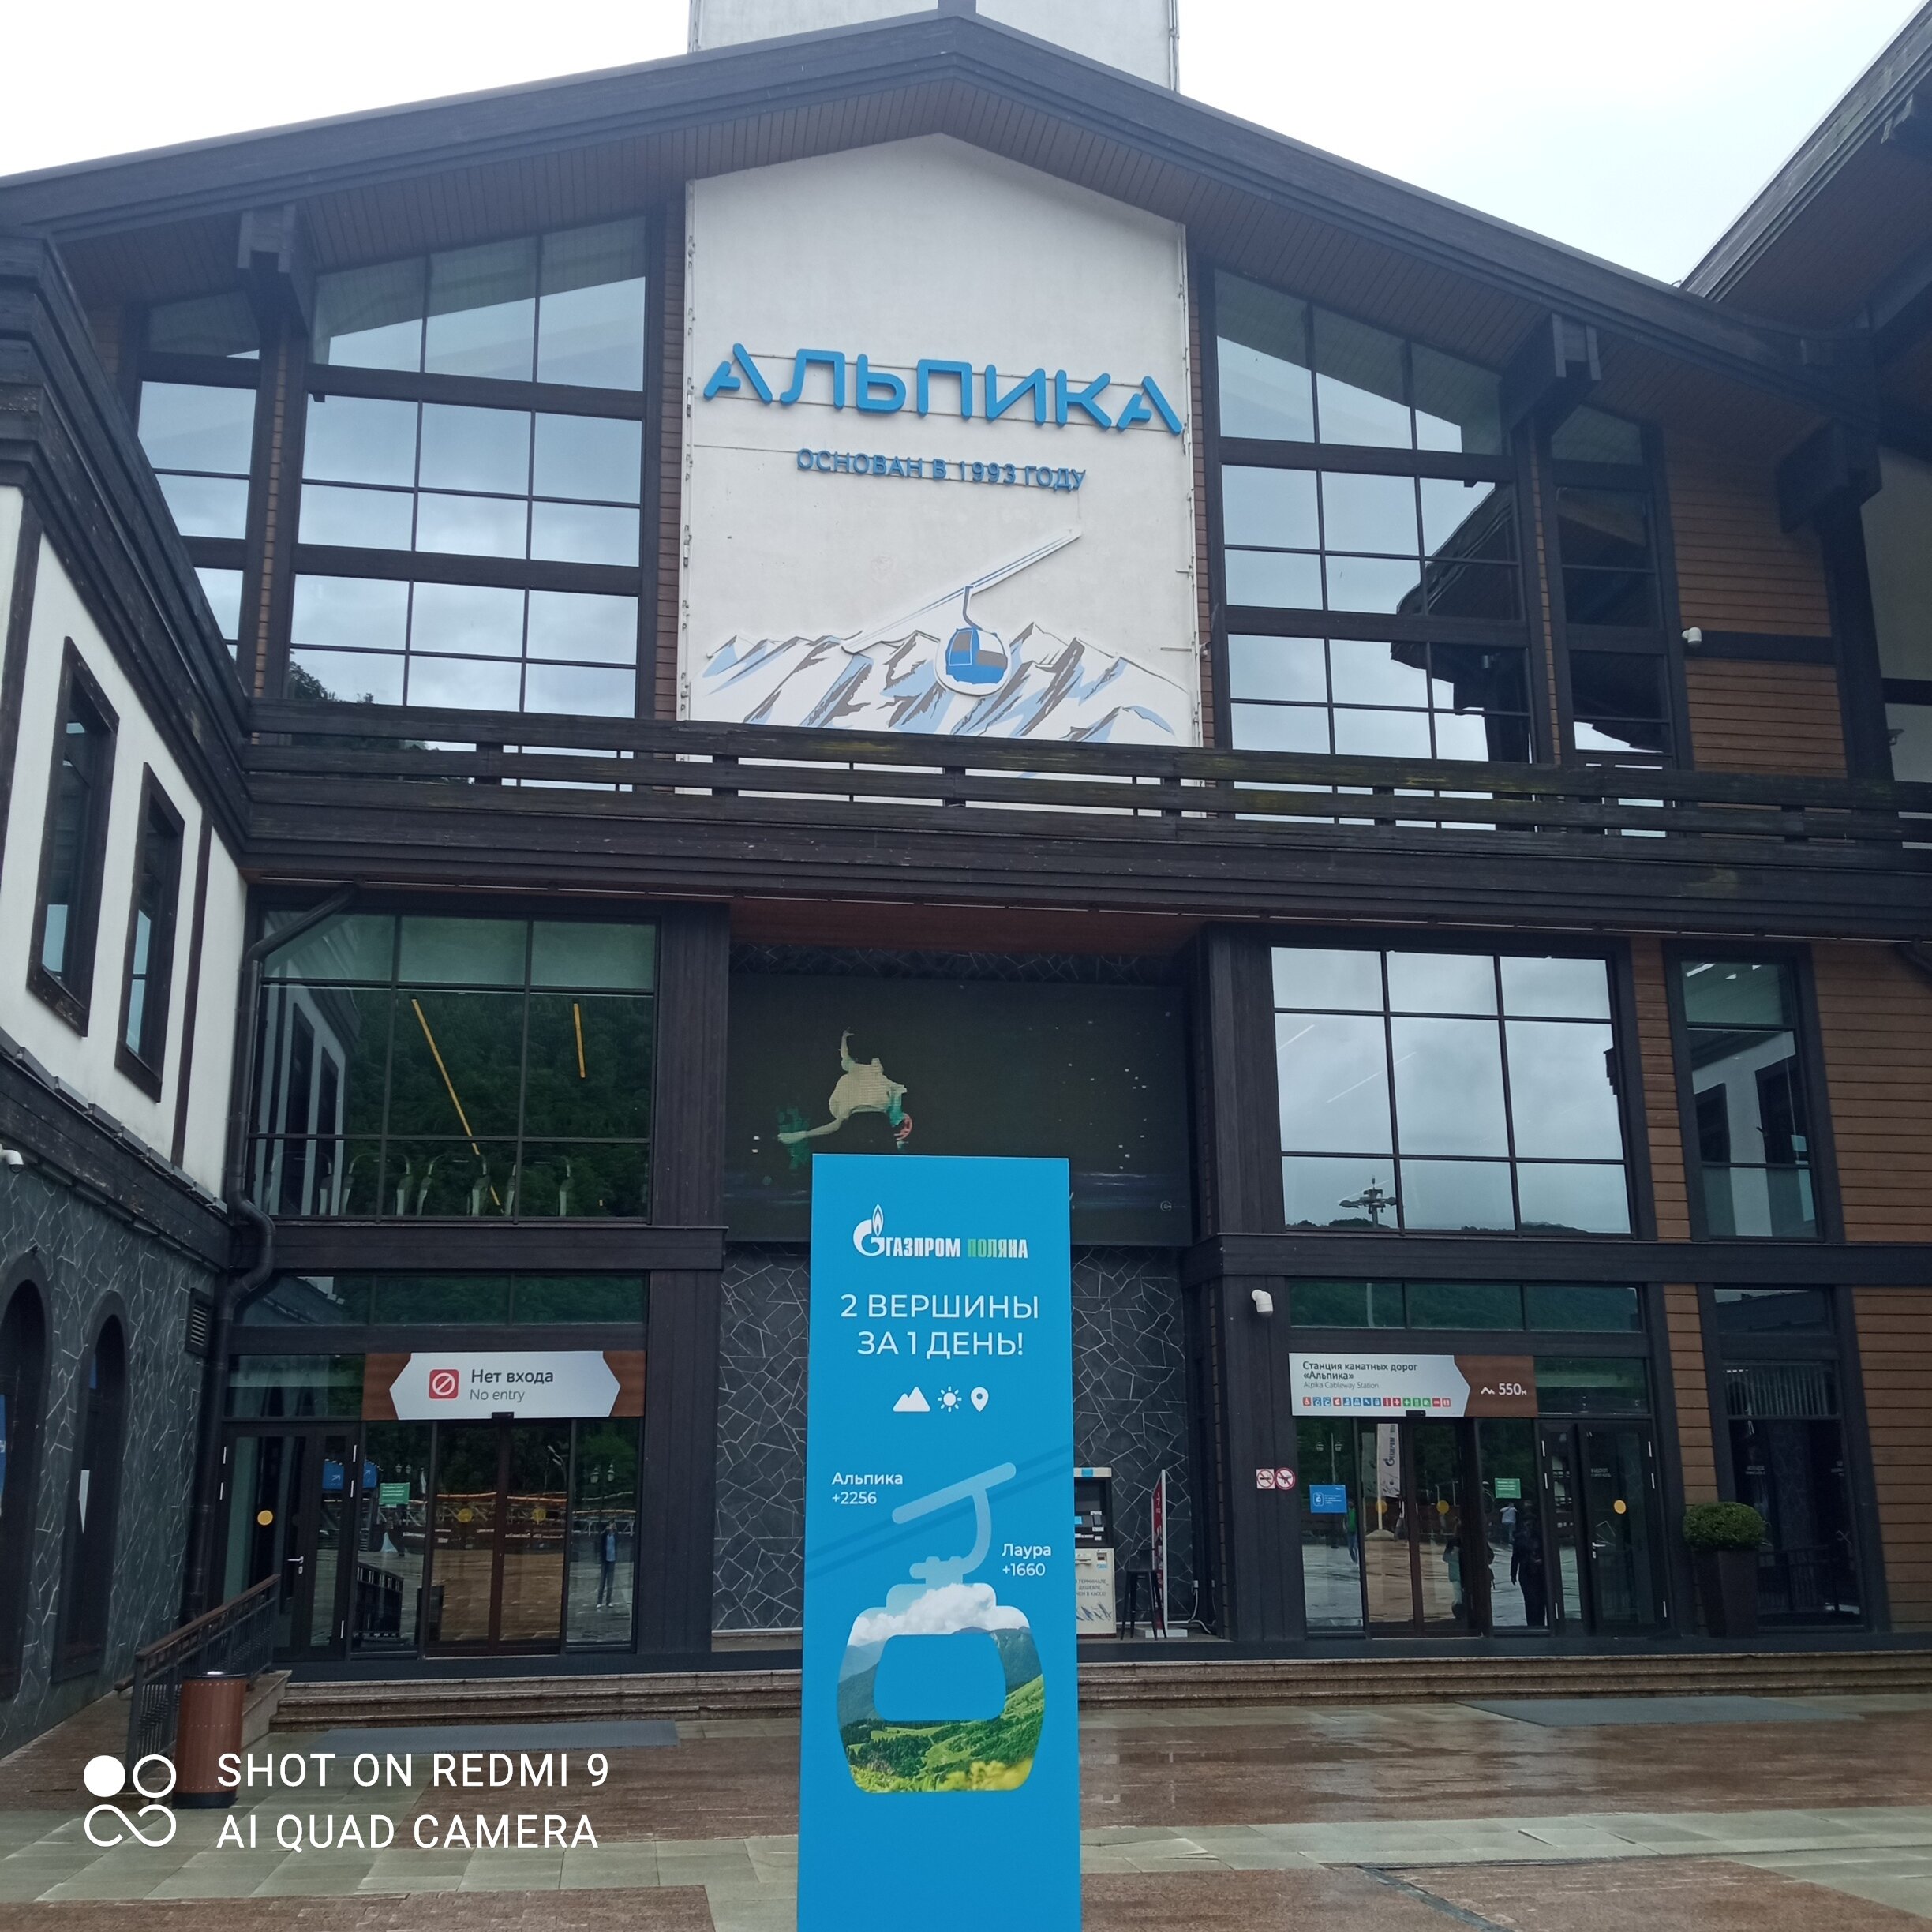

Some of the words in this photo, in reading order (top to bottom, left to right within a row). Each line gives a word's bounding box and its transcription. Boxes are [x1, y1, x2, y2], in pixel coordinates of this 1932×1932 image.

[702, 343, 1182, 436] АЛЬПИКА
[797, 448, 923, 479] ОСНОВАН
[934, 459, 948, 480] В
[958, 461, 1016, 485] 1993
[1025, 466, 1086, 492] ГОДУ
[885, 1237, 960, 1258] ГАЗПРОМ
[967, 1238, 1028, 1259] ПОЛЯНА
[840, 1294, 858, 1317] 2
[868, 1294, 1039, 1319] ВЕРШИНЫ
[857, 1331, 899, 1355] ЗА
[907, 1331, 917, 1355] 1
[926, 1331, 1024, 1360] ДЕНЬ!
[1302, 1361, 1342, 1372] Станция
[1345, 1363, 1388, 1372] канатных
[1390, 1363, 1418, 1373] дорог
[471, 1368, 502, 1383] Нет
[507, 1372, 554, 1384] входа
[1303, 1370, 1354, 1380] «Альпика»
[1303, 1381, 1324, 1390] Alpika
[1325, 1381, 1355, 1390] Cableway
[470, 1389, 489, 1400] No
[492, 1389, 525, 1403] entry
[831, 1472, 903, 1485] Альпика
[832, 1491, 877, 1505] +2256
[1002, 1543, 1052, 1559] Лаура
[1002, 1563, 1046, 1576] +1660
